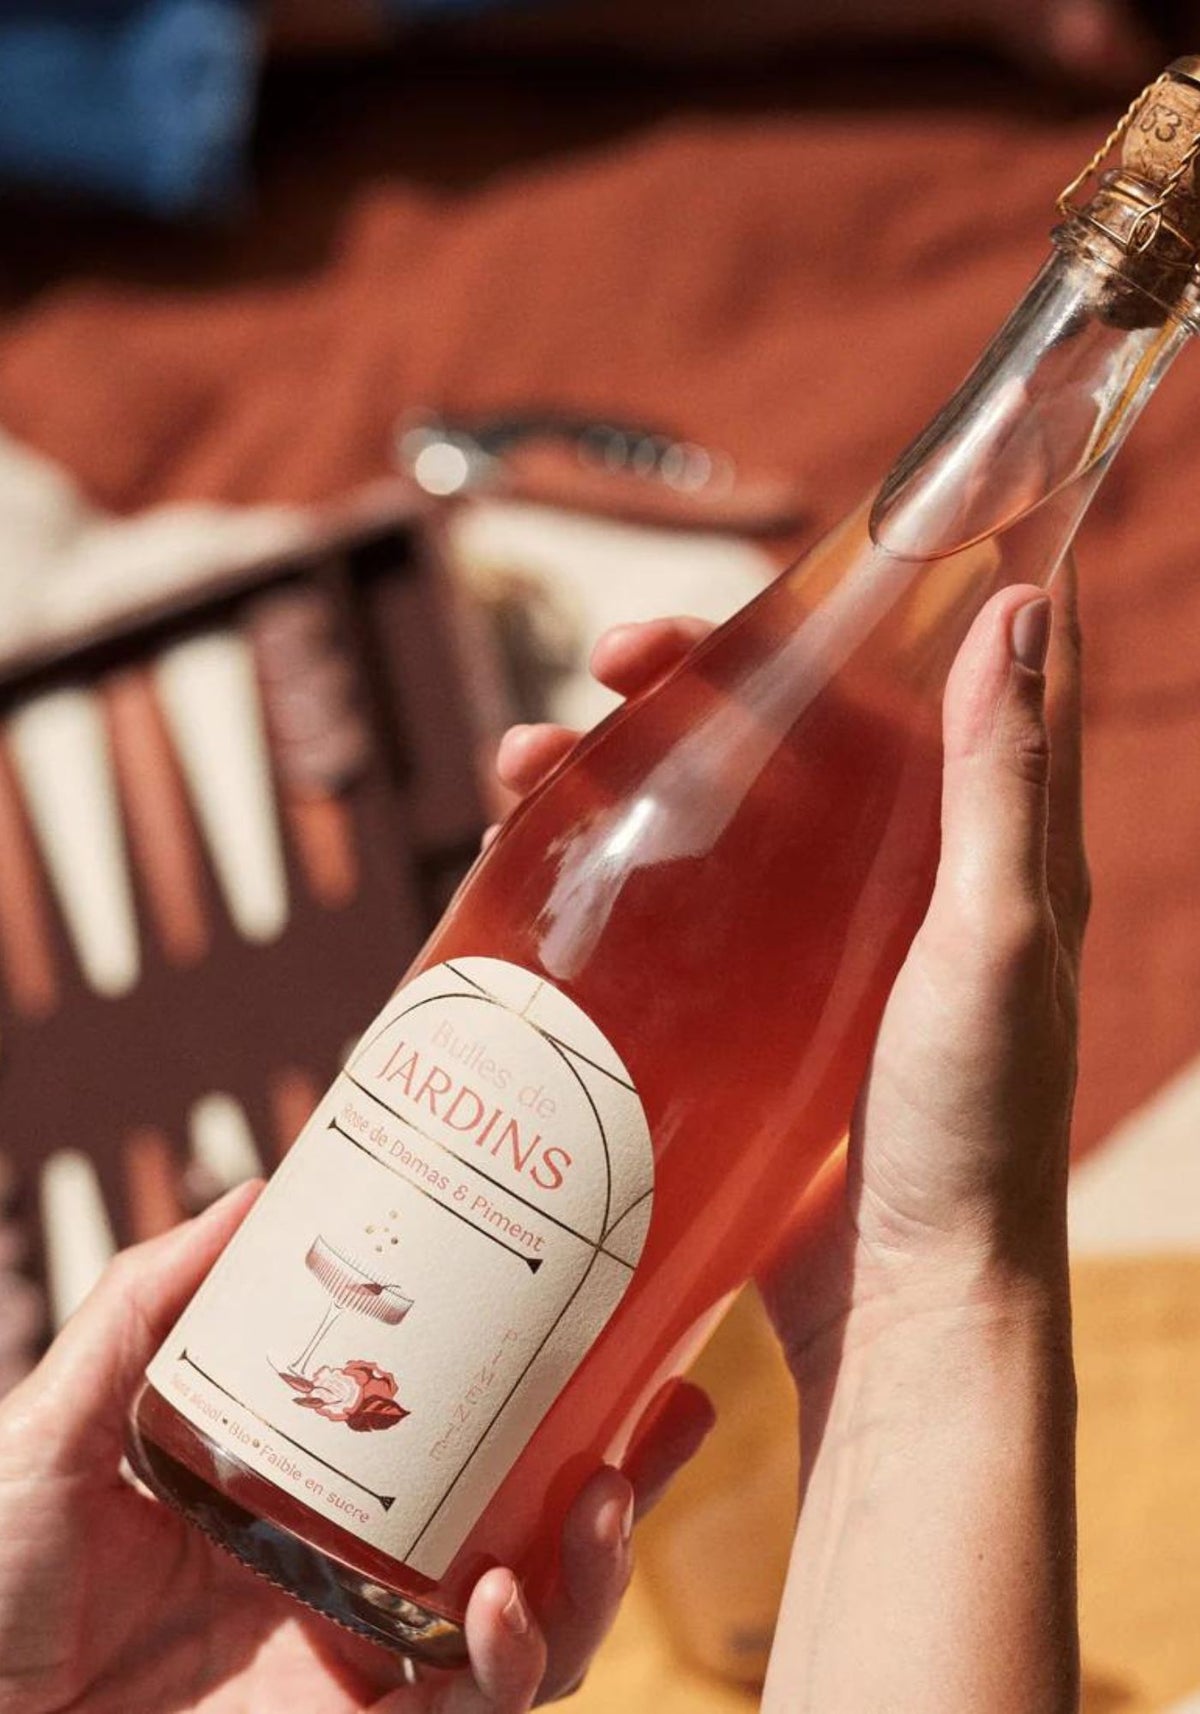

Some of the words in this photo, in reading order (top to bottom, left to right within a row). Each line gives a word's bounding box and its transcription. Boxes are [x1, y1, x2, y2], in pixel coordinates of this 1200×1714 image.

[376, 1041, 572, 1190] JARDINS
[429, 1019, 512, 1090] Bulles
[516, 1085, 557, 1120] de
[369, 1126, 389, 1147] de
[389, 1139, 450, 1190] Damas
[452, 1185, 469, 1201] &
[471, 1195, 546, 1252] Piment
[228, 1421, 251, 1445] Bio
[259, 1444, 302, 1481] Faible
[304, 1478, 324, 1496] en
[326, 1491, 370, 1523] sucre
